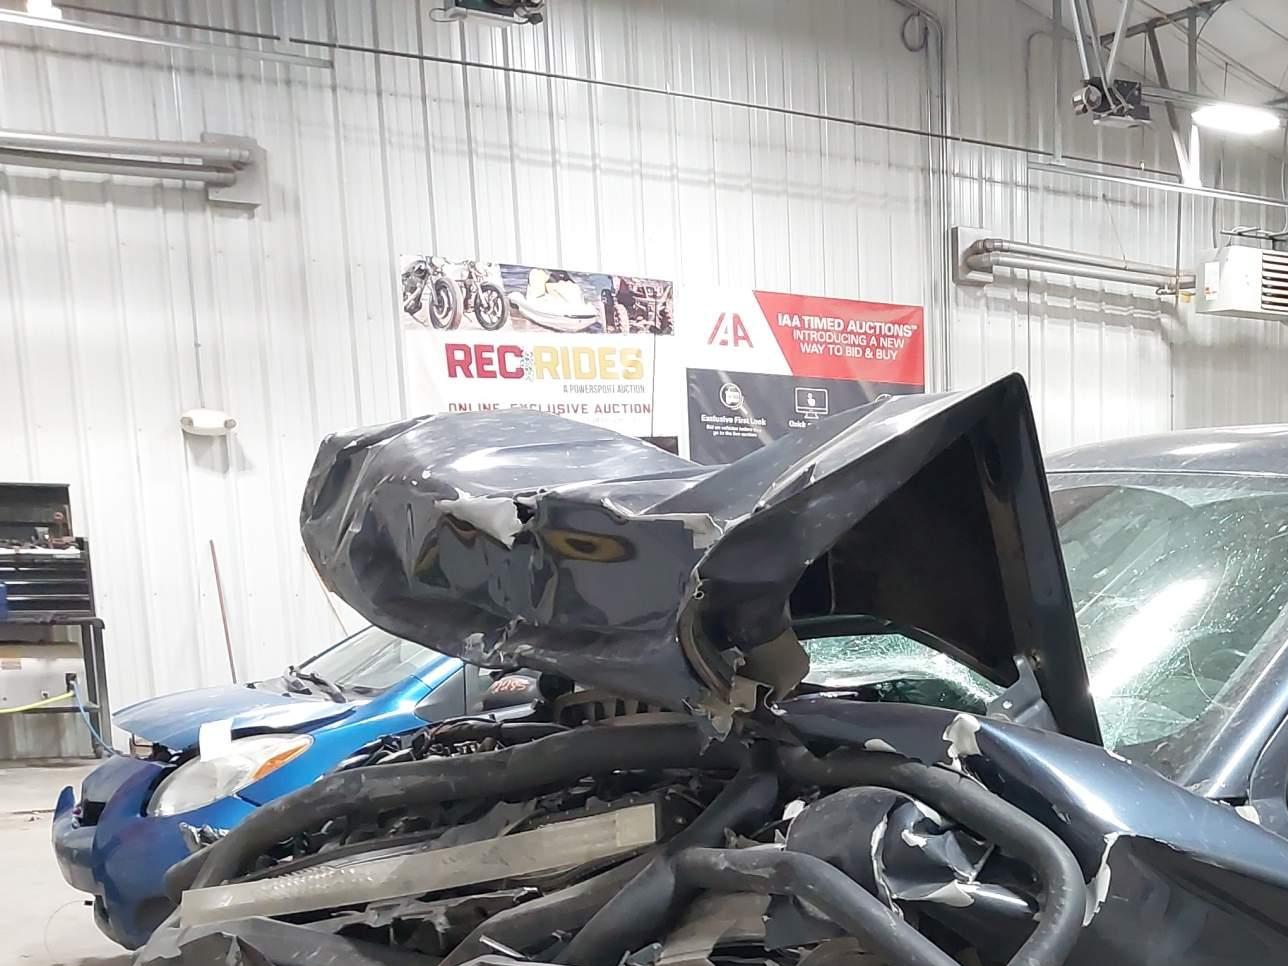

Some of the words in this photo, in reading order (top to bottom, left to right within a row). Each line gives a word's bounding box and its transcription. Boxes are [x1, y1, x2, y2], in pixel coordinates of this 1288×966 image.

[778, 312, 801, 328] IAA
[803, 315, 844, 331] TIMED
[793, 329, 867, 346] INTRODUCING
[870, 335, 878, 347] A
[879, 336, 905, 349] NEW
[800, 341, 823, 354] WAY
[826, 344, 843, 356] TO
[845, 345, 862, 358] BID
[864, 347, 873, 359] &
[875, 348, 898, 361] BUY
[445, 343, 524, 379] REC
[534, 345, 645, 380] RIDES
[563, 384, 569, 393] A
[617, 384, 645, 394] AUCTION
[594, 403, 652, 414] AUCTION
